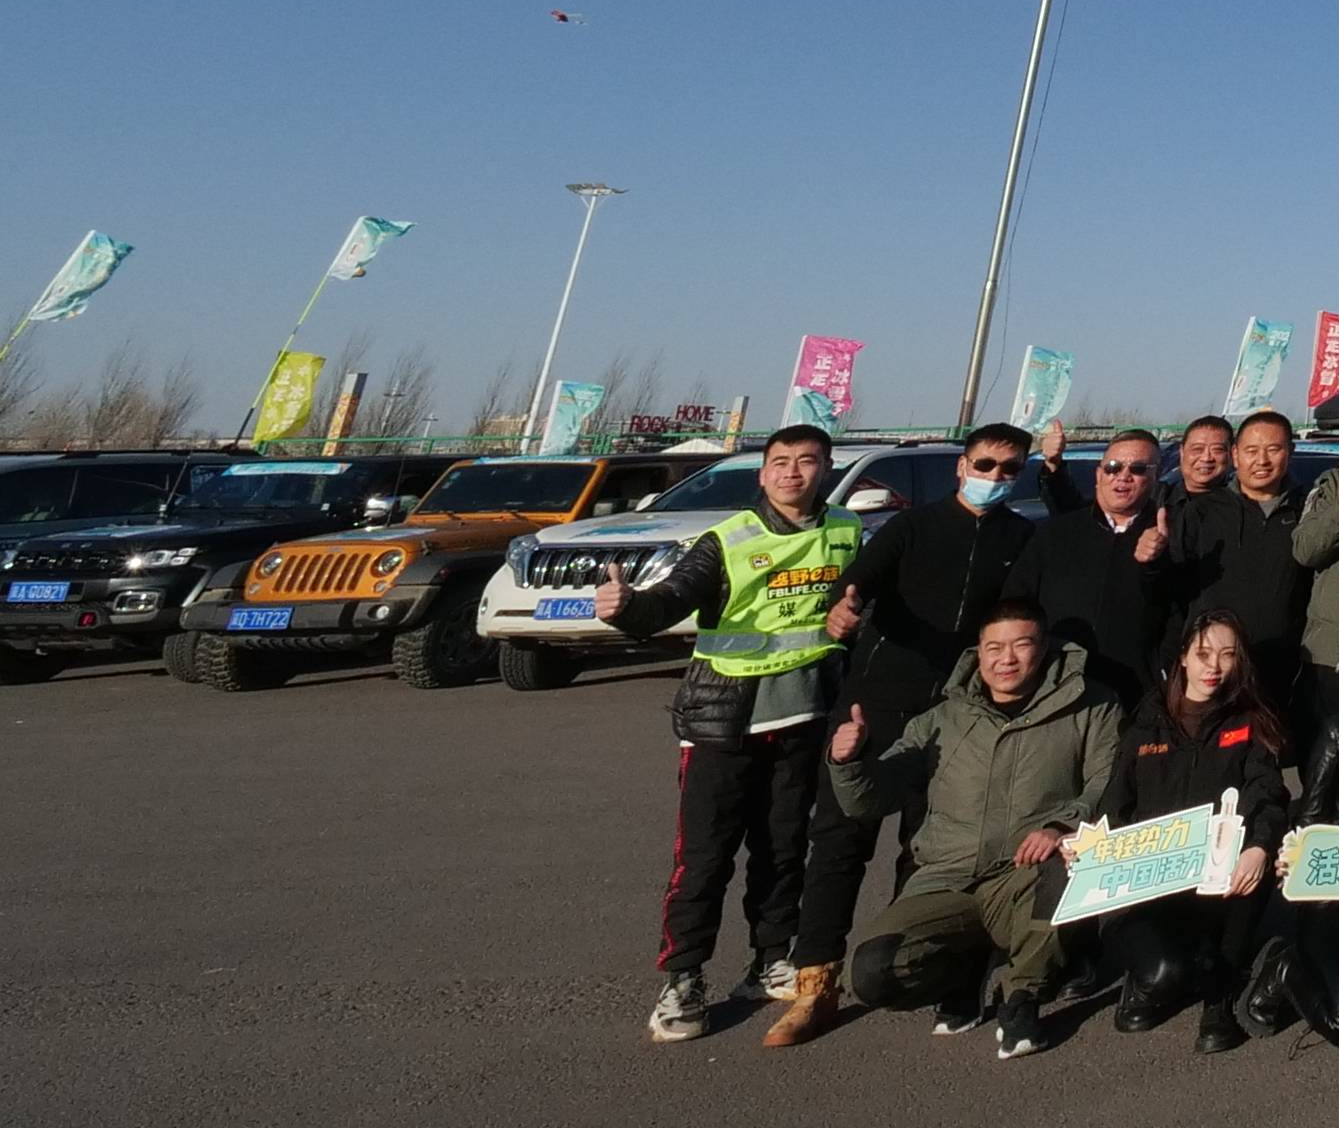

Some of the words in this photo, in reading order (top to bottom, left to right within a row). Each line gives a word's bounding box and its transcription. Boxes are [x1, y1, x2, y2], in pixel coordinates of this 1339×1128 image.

[676, 405, 716, 422] HOME
[1092, 818, 1192, 864] 年轻势力
[1099, 849, 1206, 899] 中国活力
